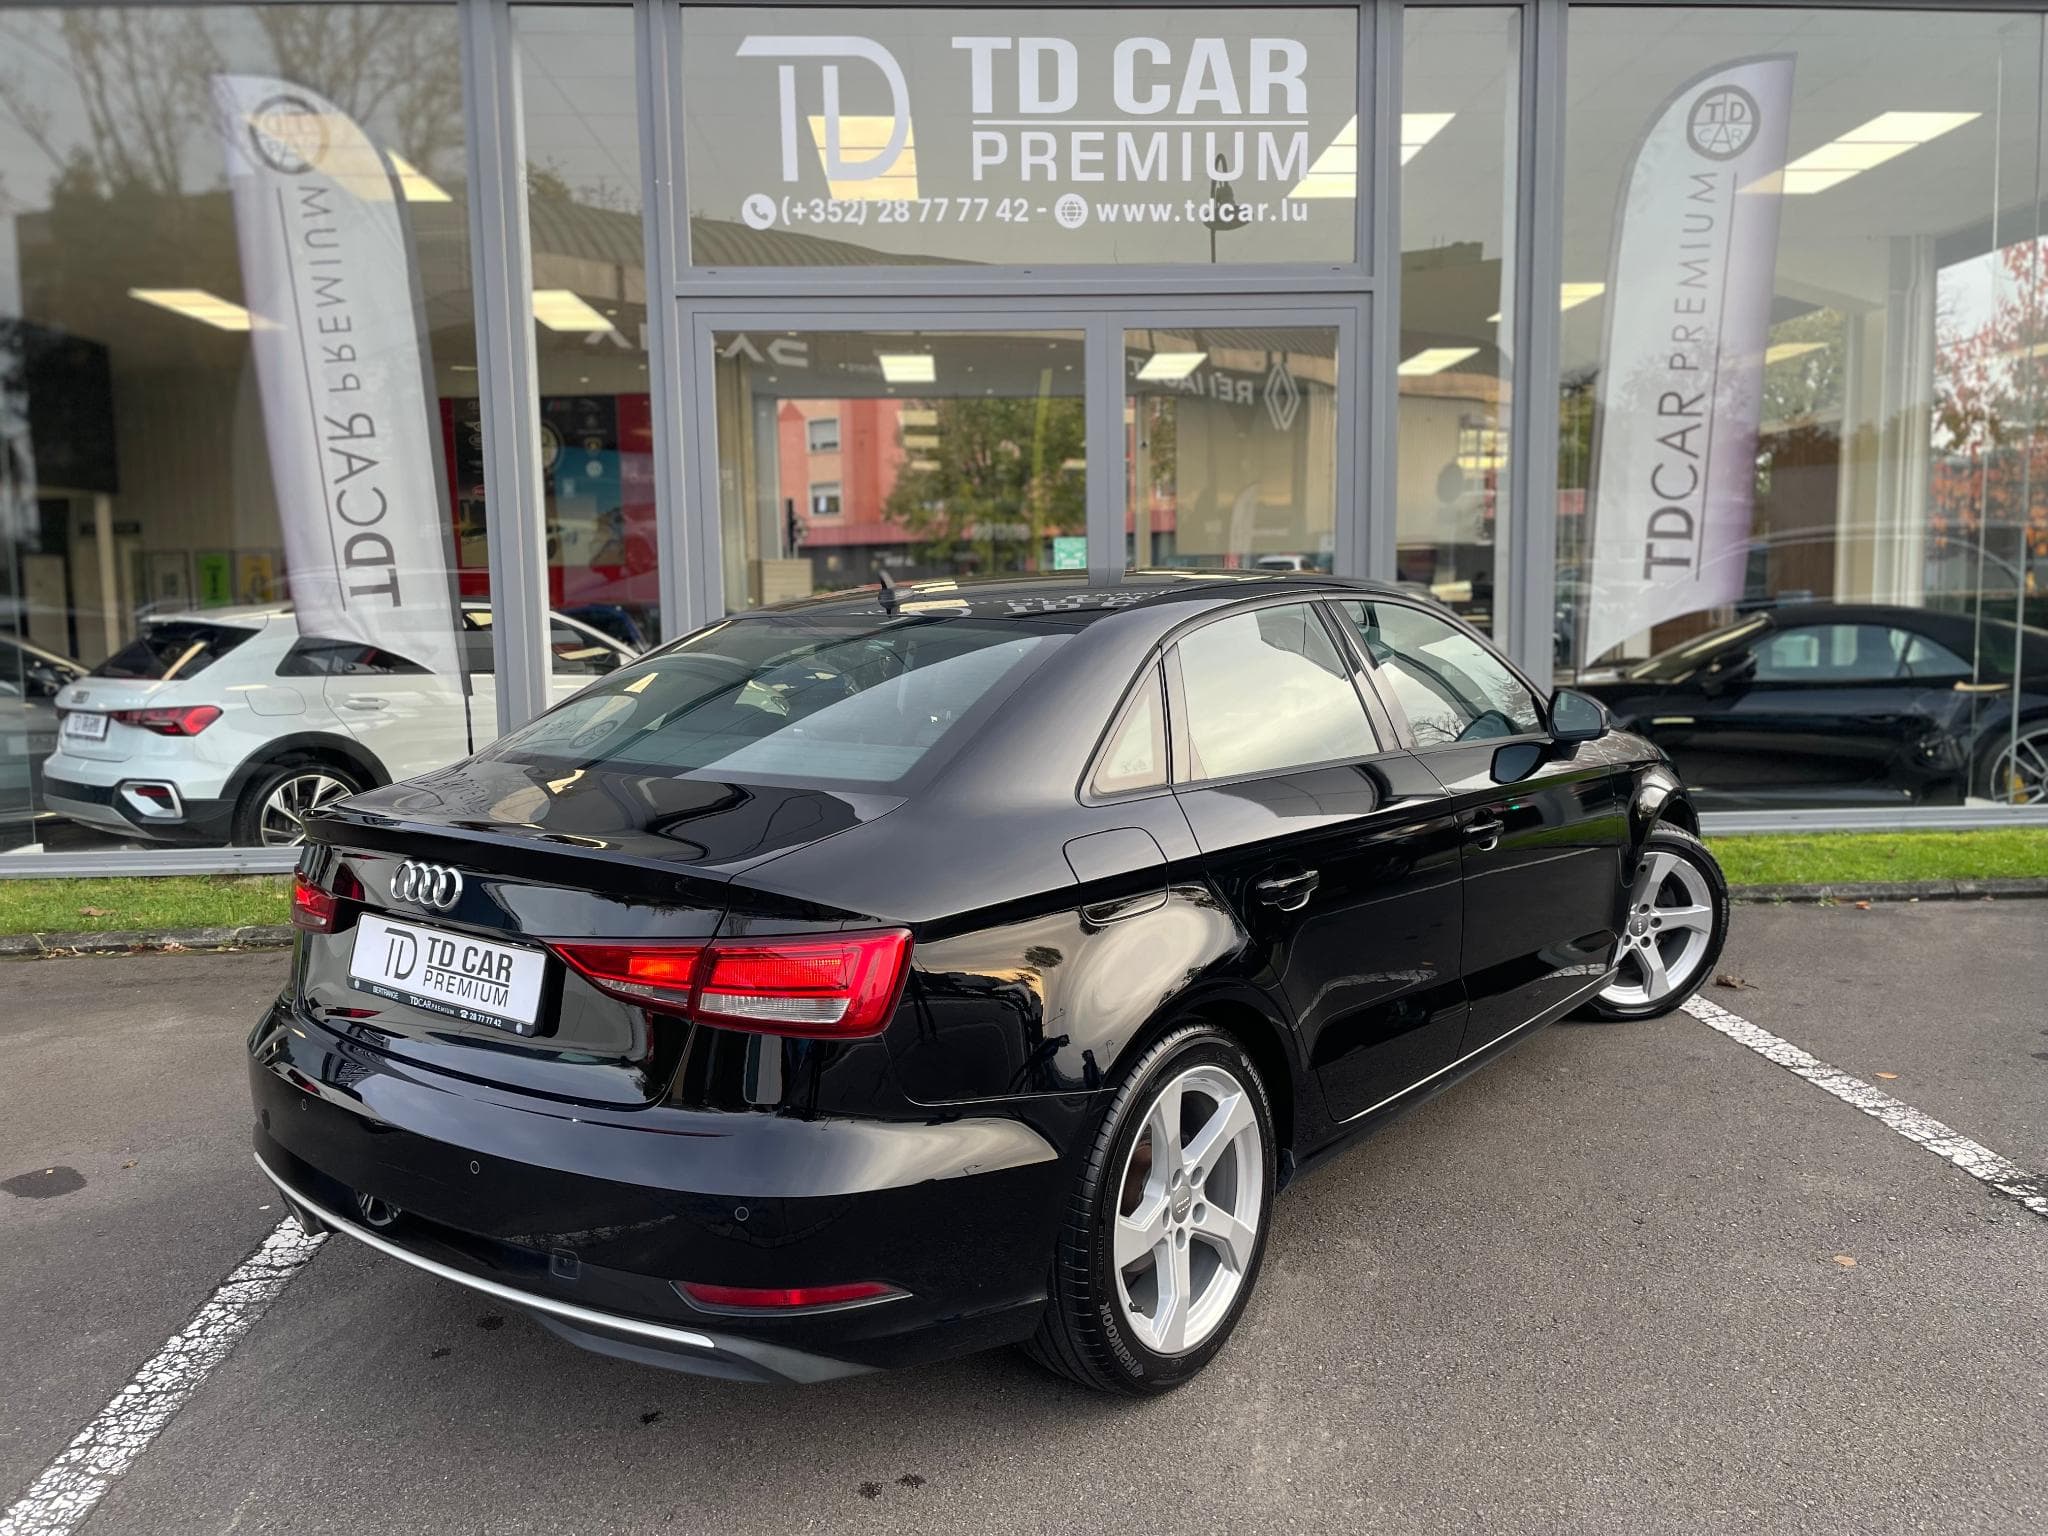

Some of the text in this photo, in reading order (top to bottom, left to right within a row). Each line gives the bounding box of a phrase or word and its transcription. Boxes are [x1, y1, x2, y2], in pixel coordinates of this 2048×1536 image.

[952, 37, 1309, 114] TD CAR
[973, 131, 1309, 182] PREMIUM
[781, 196, 867, 227] (+352)
[878, 198, 911, 223] 28
[917, 198, 956, 223] 77
[958, 198, 994, 223] 77
[995, 198, 1029, 223] 42
[1096, 198, 1309, 223] www.tdcar.lu
[1643, 171, 1718, 581] TDCAR PREMIUM
[427, 936, 513, 983] TD CAR
[423, 969, 509, 1008] PREMIUM
